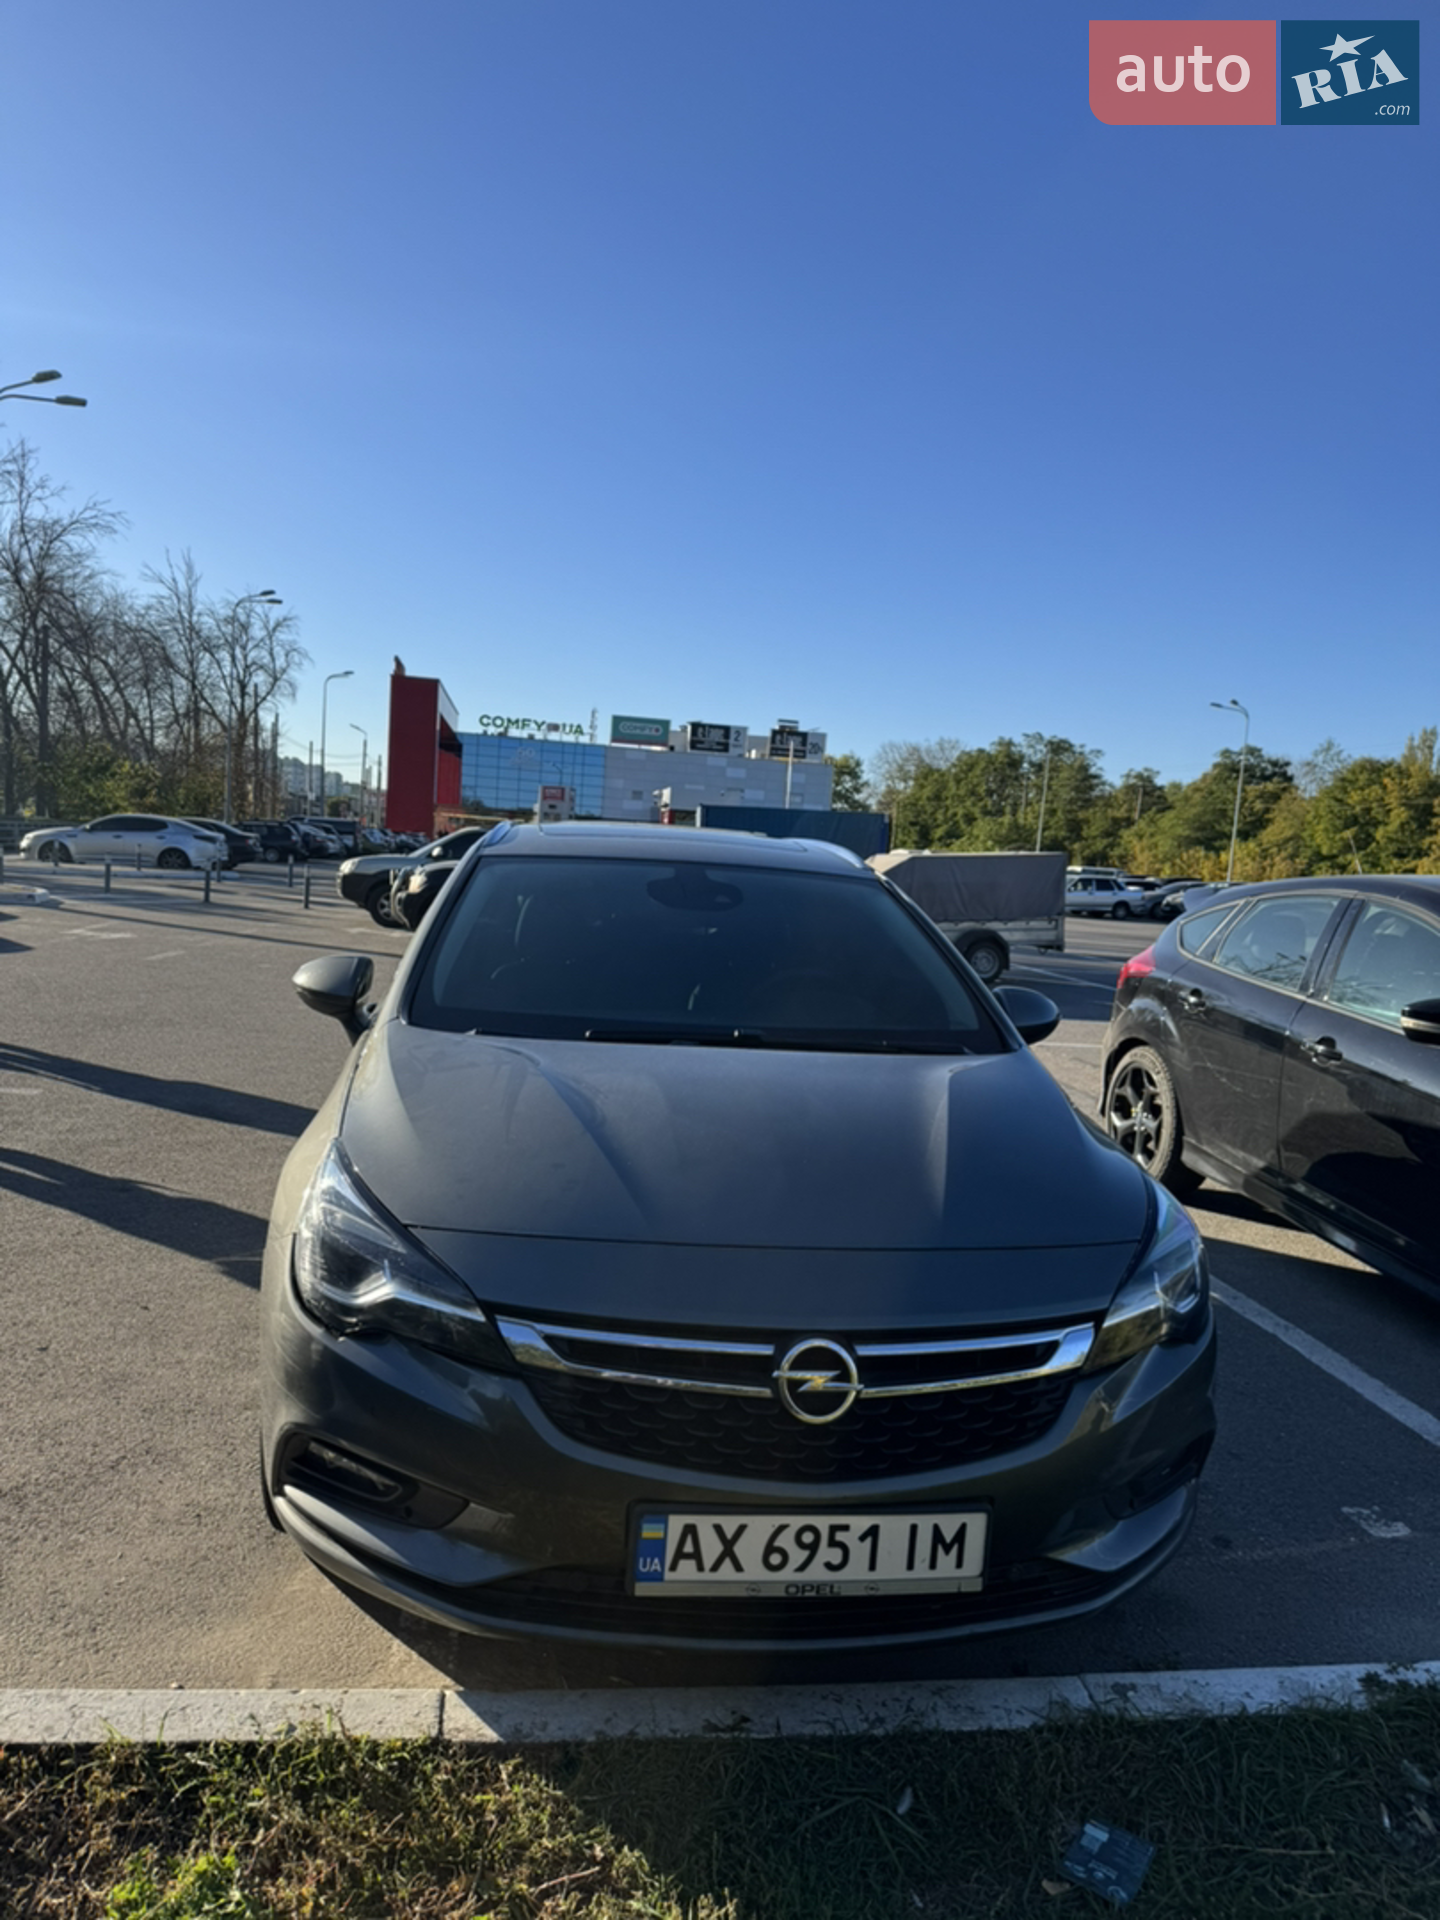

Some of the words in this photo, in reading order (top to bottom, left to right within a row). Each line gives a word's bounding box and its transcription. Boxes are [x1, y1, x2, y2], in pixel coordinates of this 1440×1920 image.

[479, 714, 546, 731] COMFY
[639, 1557, 661, 1572] UA
[668, 1523, 748, 1572] AX
[761, 1524, 880, 1573] 6951
[906, 1522, 967, 1571] IM
[785, 1583, 841, 1596] OPEL
